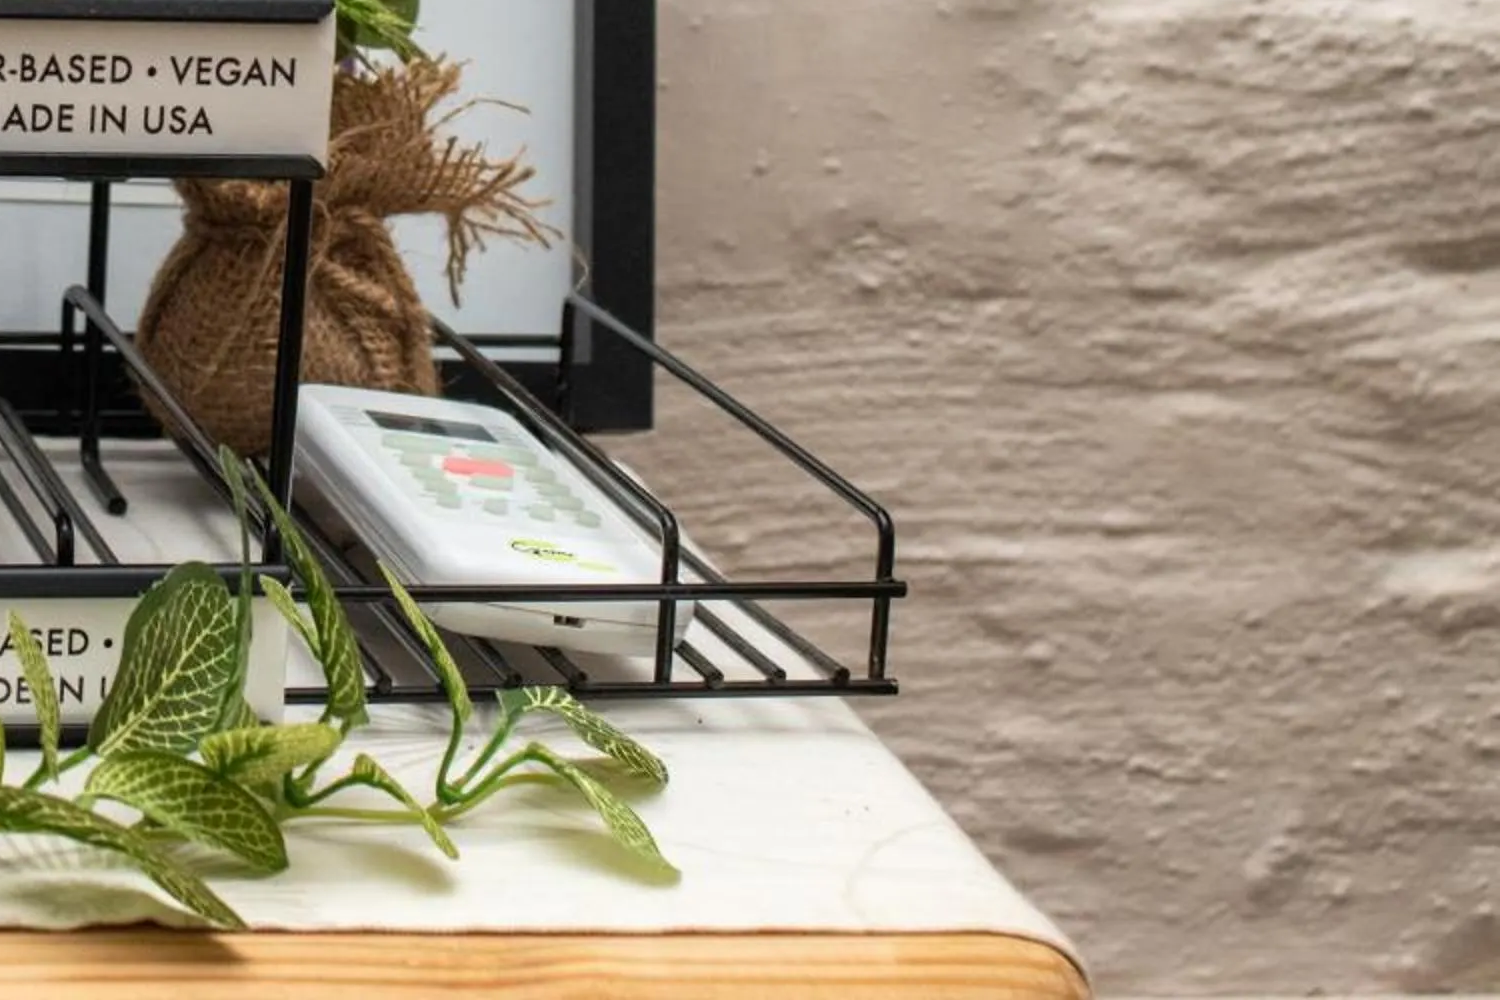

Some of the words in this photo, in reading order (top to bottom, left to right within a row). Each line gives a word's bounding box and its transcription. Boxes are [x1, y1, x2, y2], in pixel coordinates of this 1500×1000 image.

[171, 56, 296, 87] VEGAN
[89, 104, 126, 134] IN
[143, 105, 213, 136] USA
